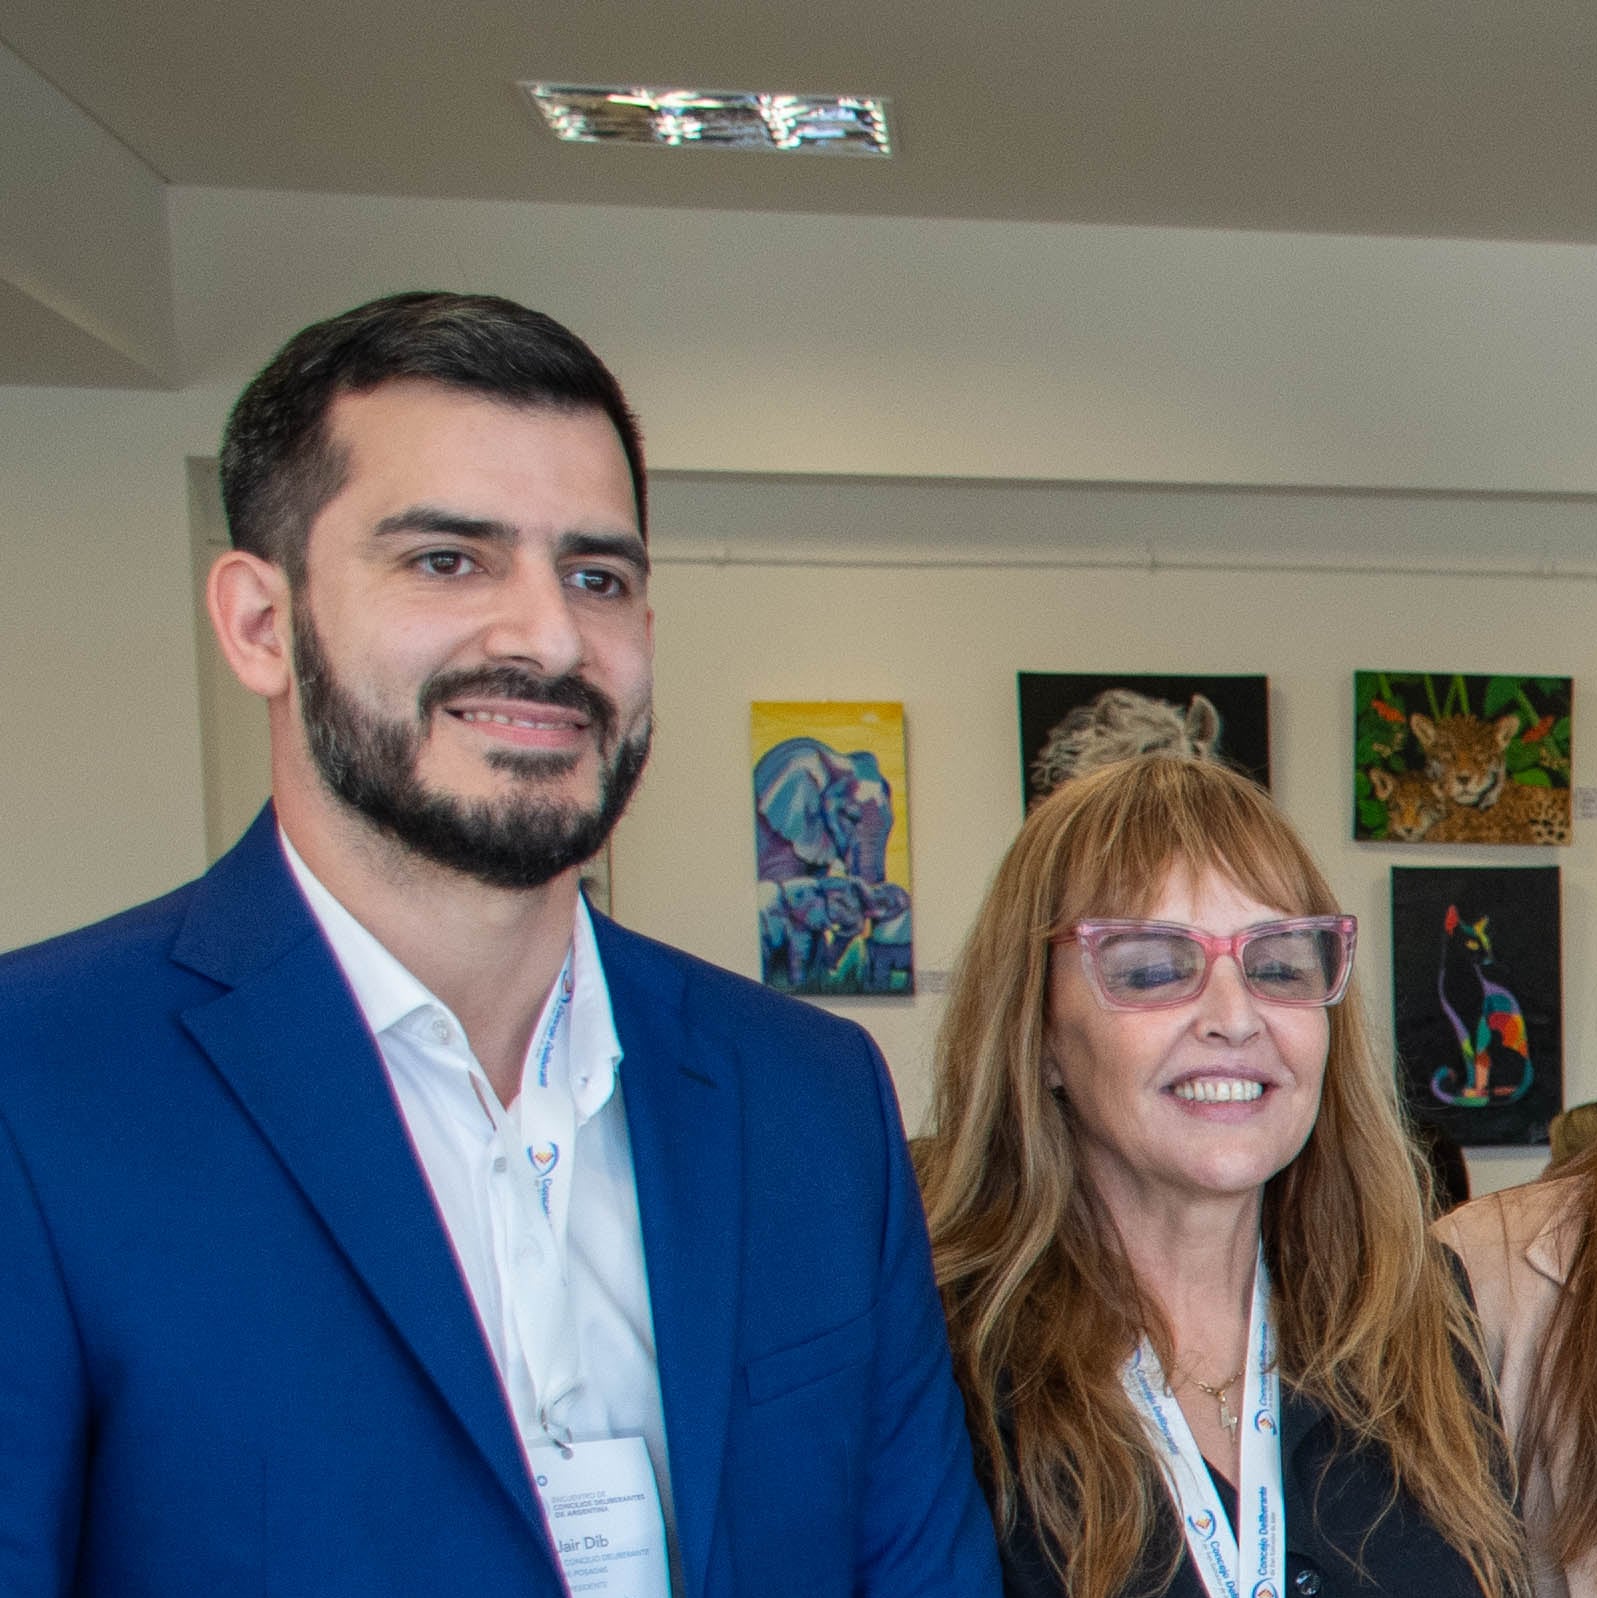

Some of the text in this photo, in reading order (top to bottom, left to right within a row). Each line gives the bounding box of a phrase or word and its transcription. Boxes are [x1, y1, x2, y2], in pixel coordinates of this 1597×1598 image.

[584, 1535, 610, 1549] Dib
[1258, 1486, 1270, 1576] Concejo Deliberante
[1210, 1540, 1230, 1582] Concejo
